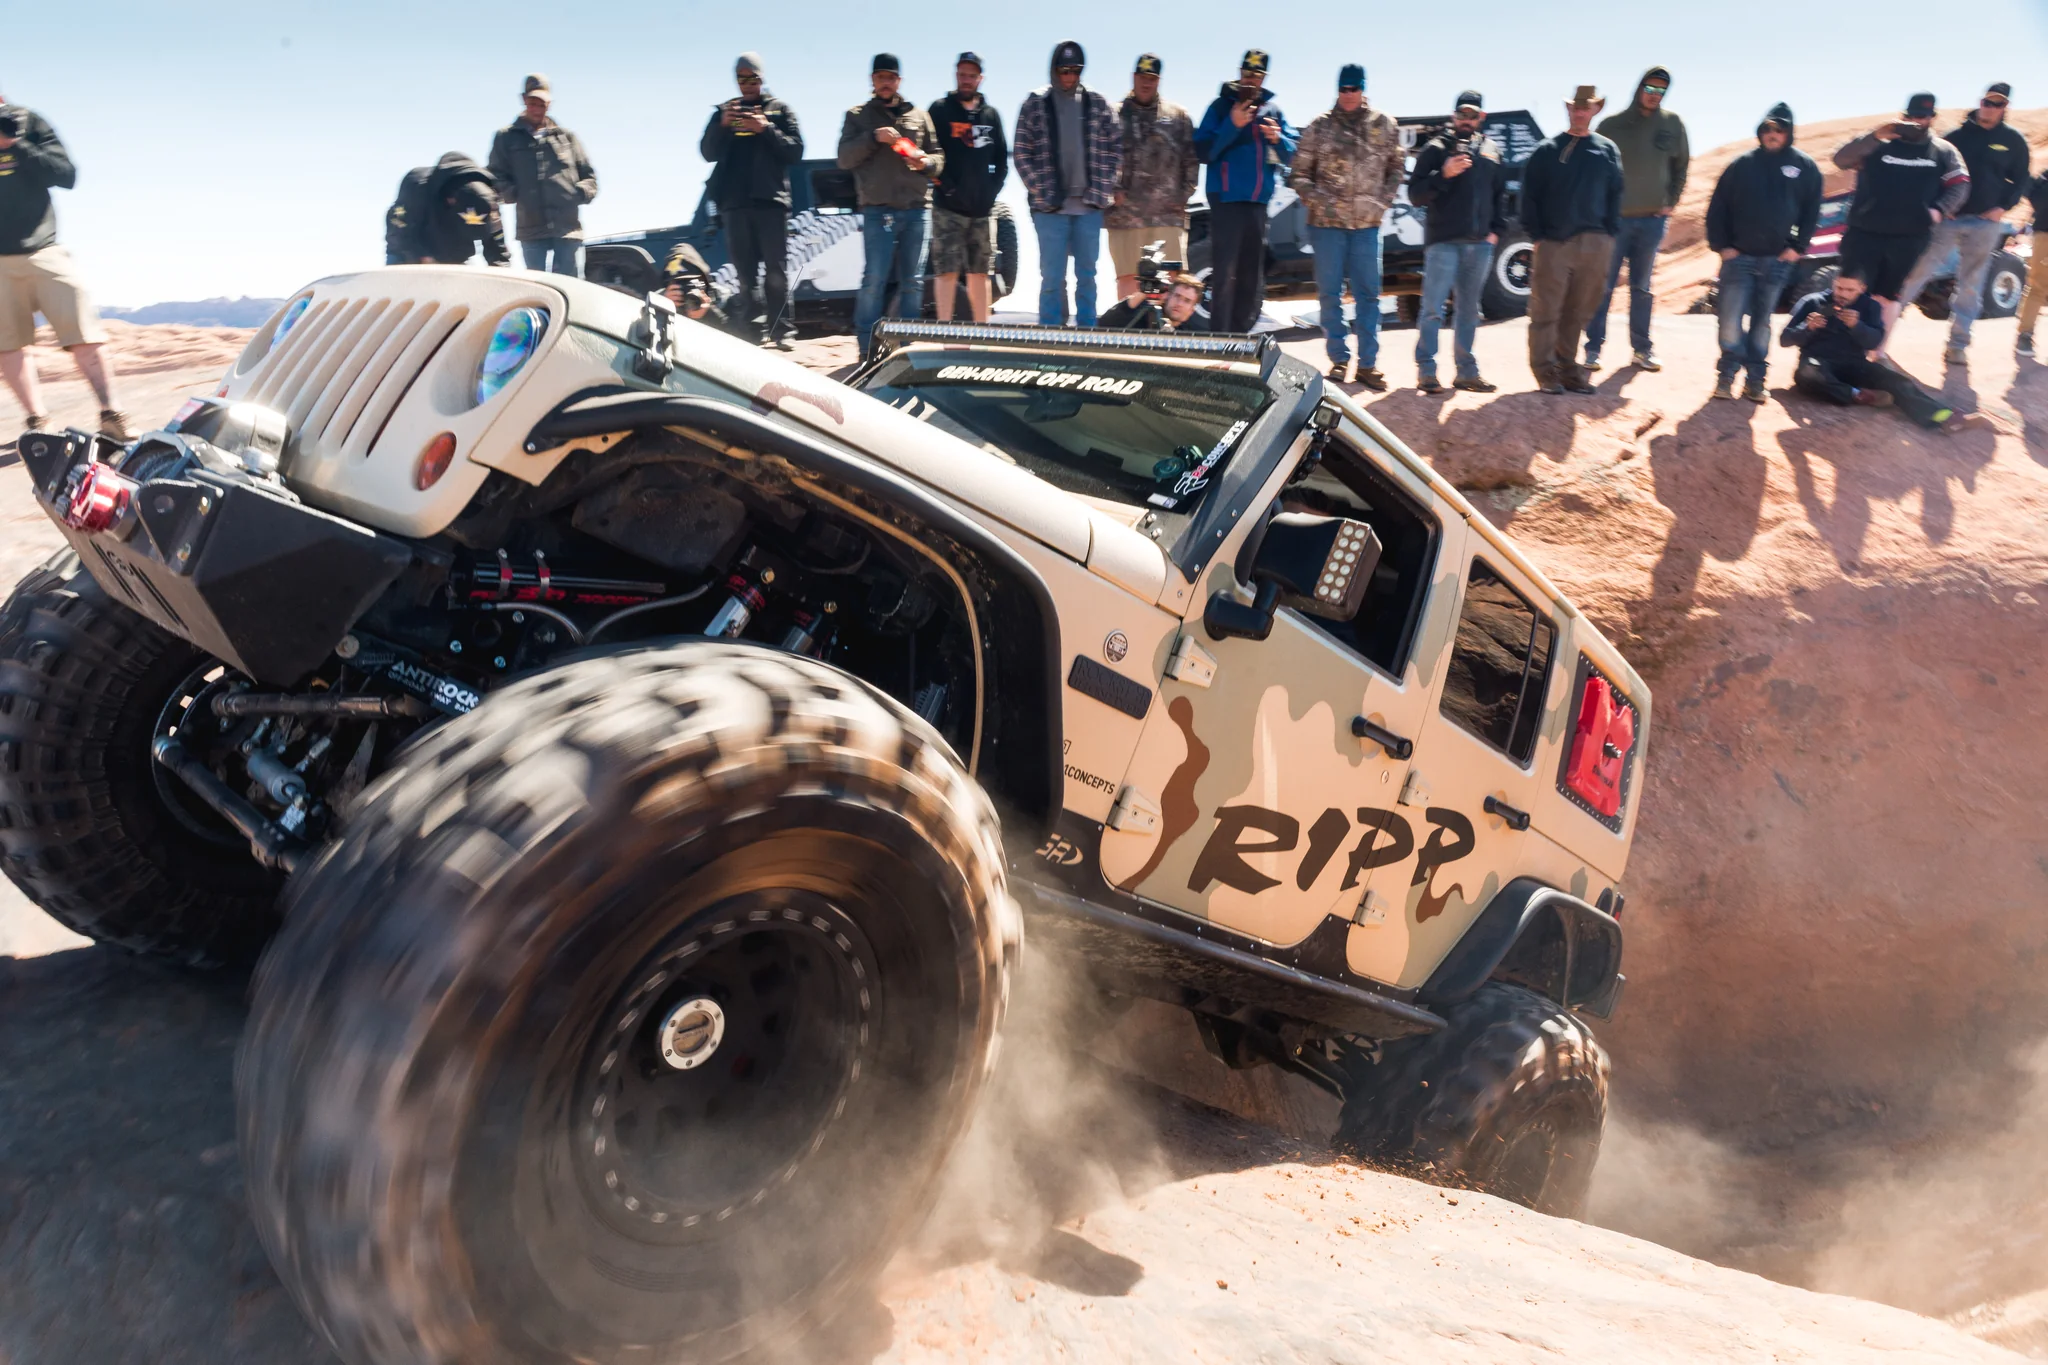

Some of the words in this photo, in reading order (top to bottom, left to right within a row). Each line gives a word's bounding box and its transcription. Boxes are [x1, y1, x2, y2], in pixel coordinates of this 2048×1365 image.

[937, 365, 1041, 384] GEN-RIGHT
[1036, 372, 1083, 389] OFF
[1077, 376, 1144, 395] ROAD
[392, 660, 479, 708] ANTIROCK
[1063, 764, 1115, 795] 1CONCEPTS
[1187, 805, 1476, 895] RIPP
